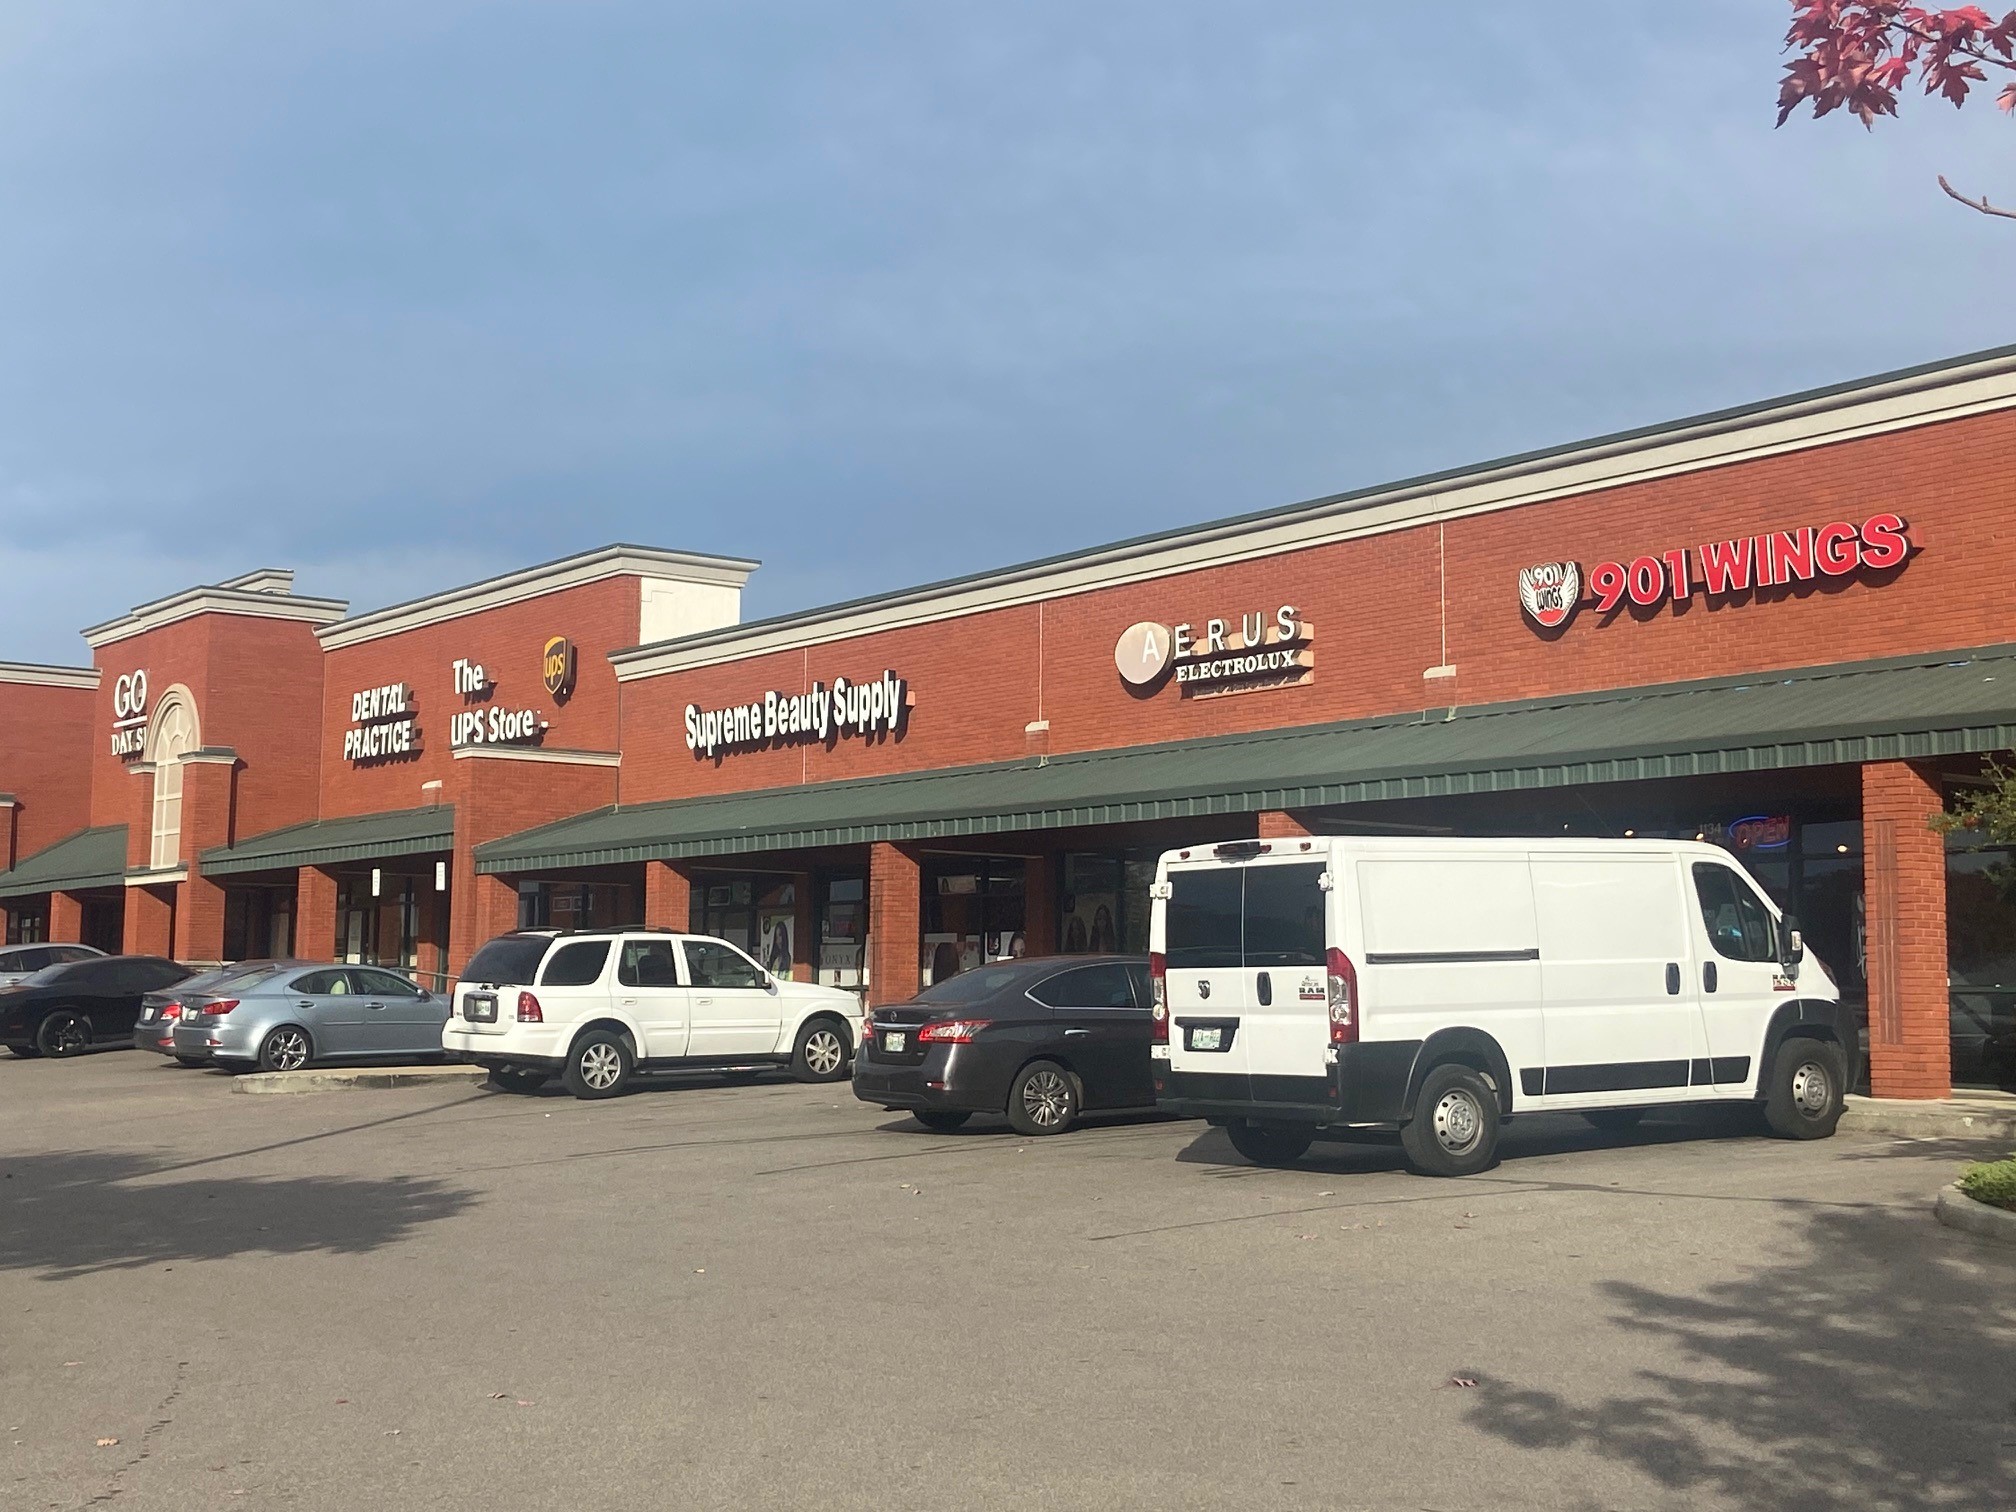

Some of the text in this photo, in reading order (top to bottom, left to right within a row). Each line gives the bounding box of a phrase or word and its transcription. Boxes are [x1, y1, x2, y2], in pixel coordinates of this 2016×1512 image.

[1533, 564, 1560, 587] 901
[1590, 513, 1907, 612] 901 WINGS
[1535, 586, 1563, 611] WINGS
[1141, 605, 1297, 664] AERUS
[452, 658, 484, 694] The
[544, 653, 564, 685] ups
[1175, 649, 1296, 683] ELECTROLUX
[114, 669, 147, 718] GO
[351, 682, 406, 723] DENTAL
[451, 705, 534, 747] UPS Store
[685, 669, 901, 757] Supreme Beauty Supply
[111, 730, 135, 756] DAY
[343, 720, 411, 761] PRACTICE
[1736, 816, 1790, 849] OPEN
